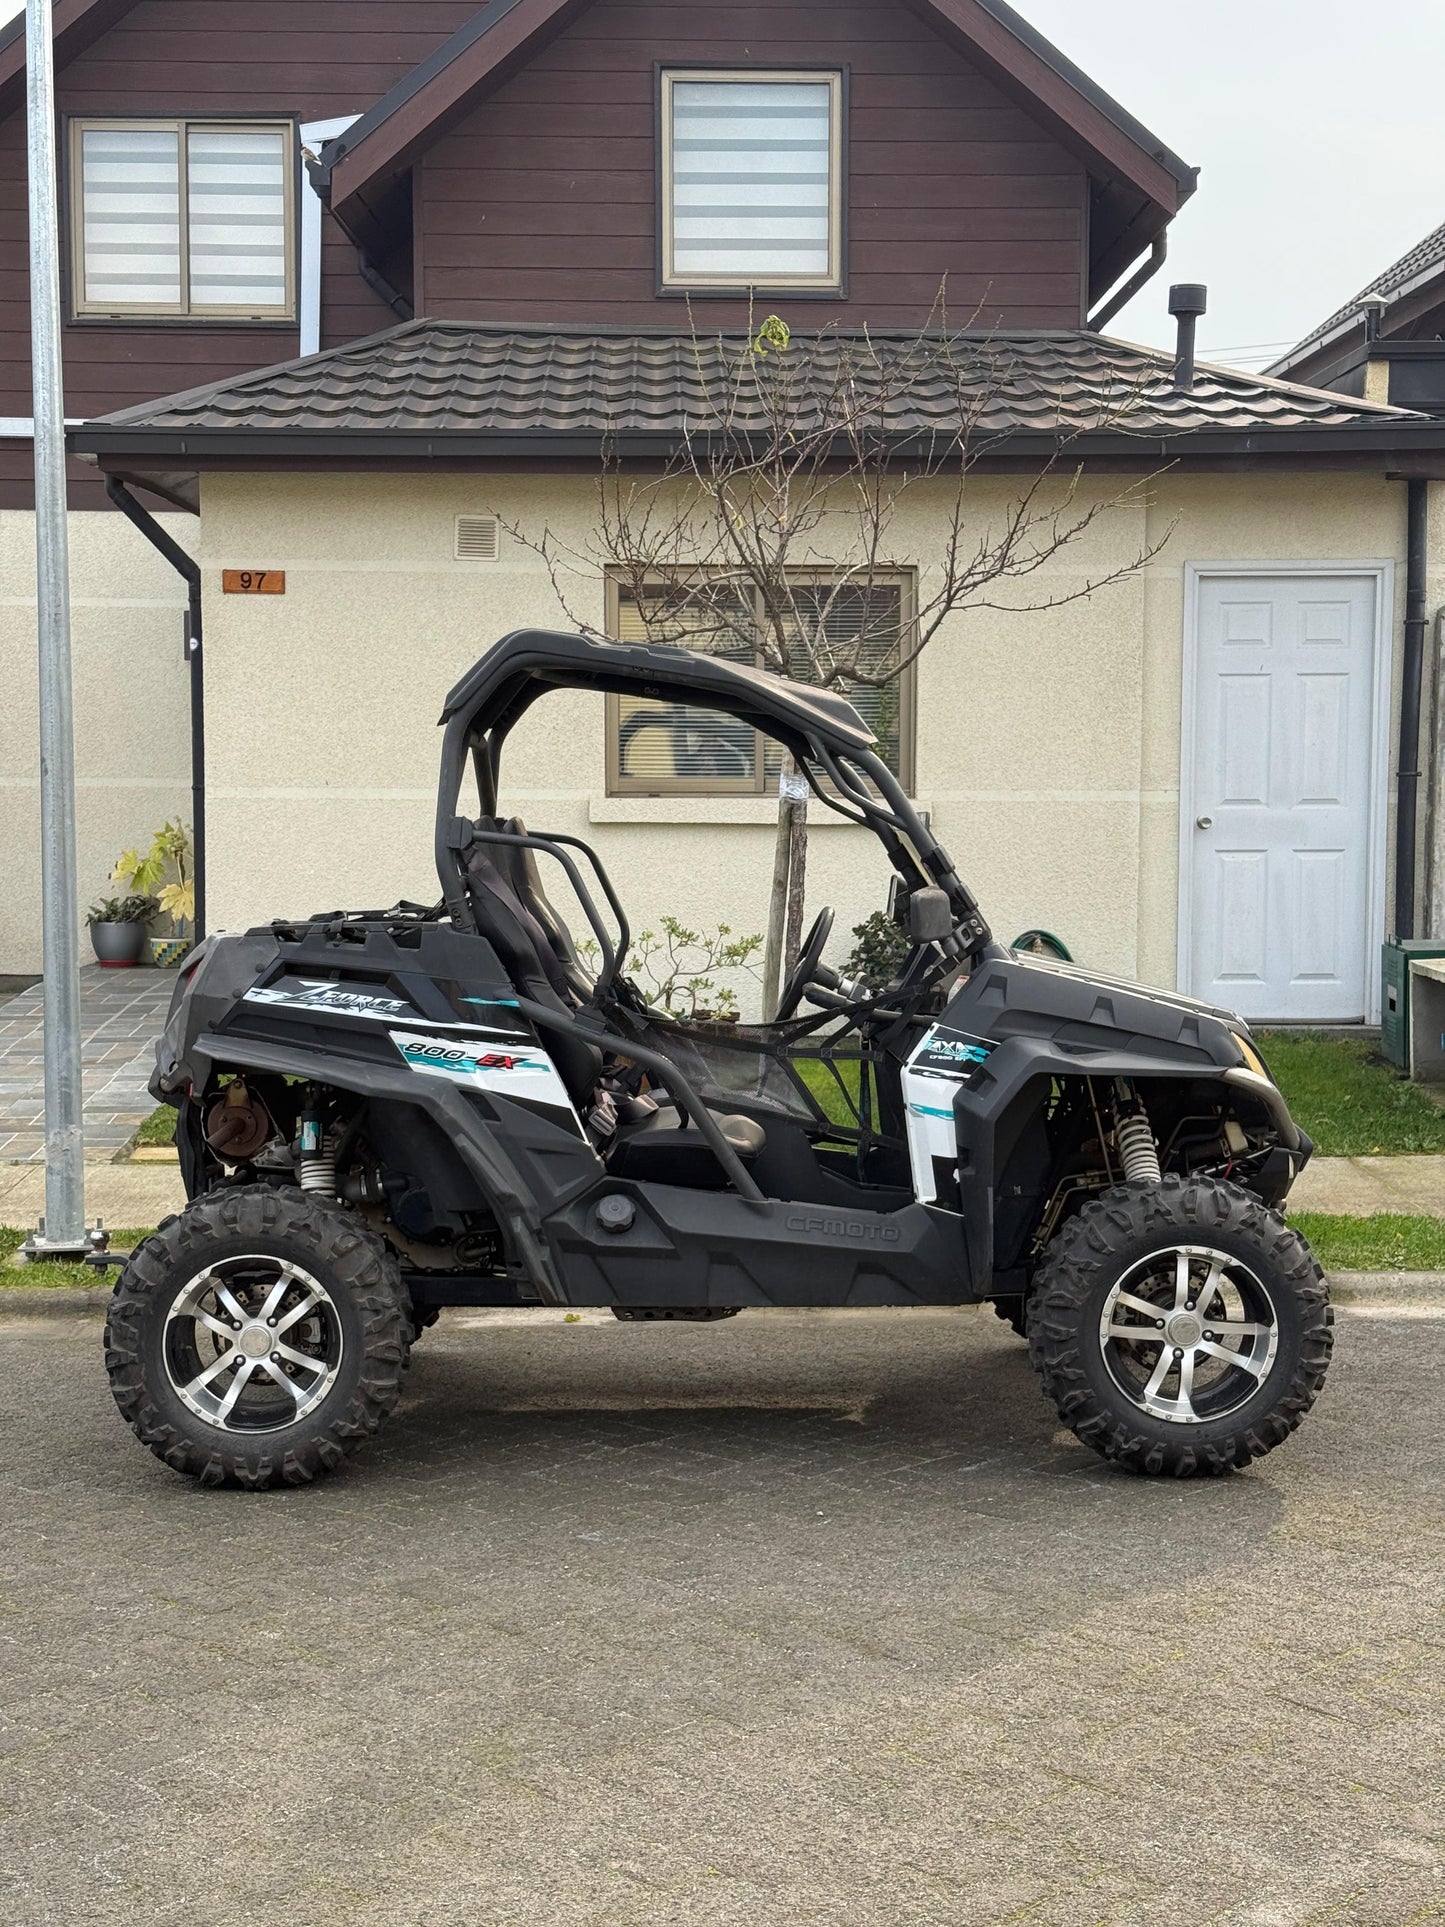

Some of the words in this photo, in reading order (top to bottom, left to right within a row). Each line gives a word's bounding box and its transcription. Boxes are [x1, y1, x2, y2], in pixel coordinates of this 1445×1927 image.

[240, 571, 267, 591] 97
[404, 1042, 523, 1070] 800-EX
[786, 1216, 900, 1242] CFMOTO
